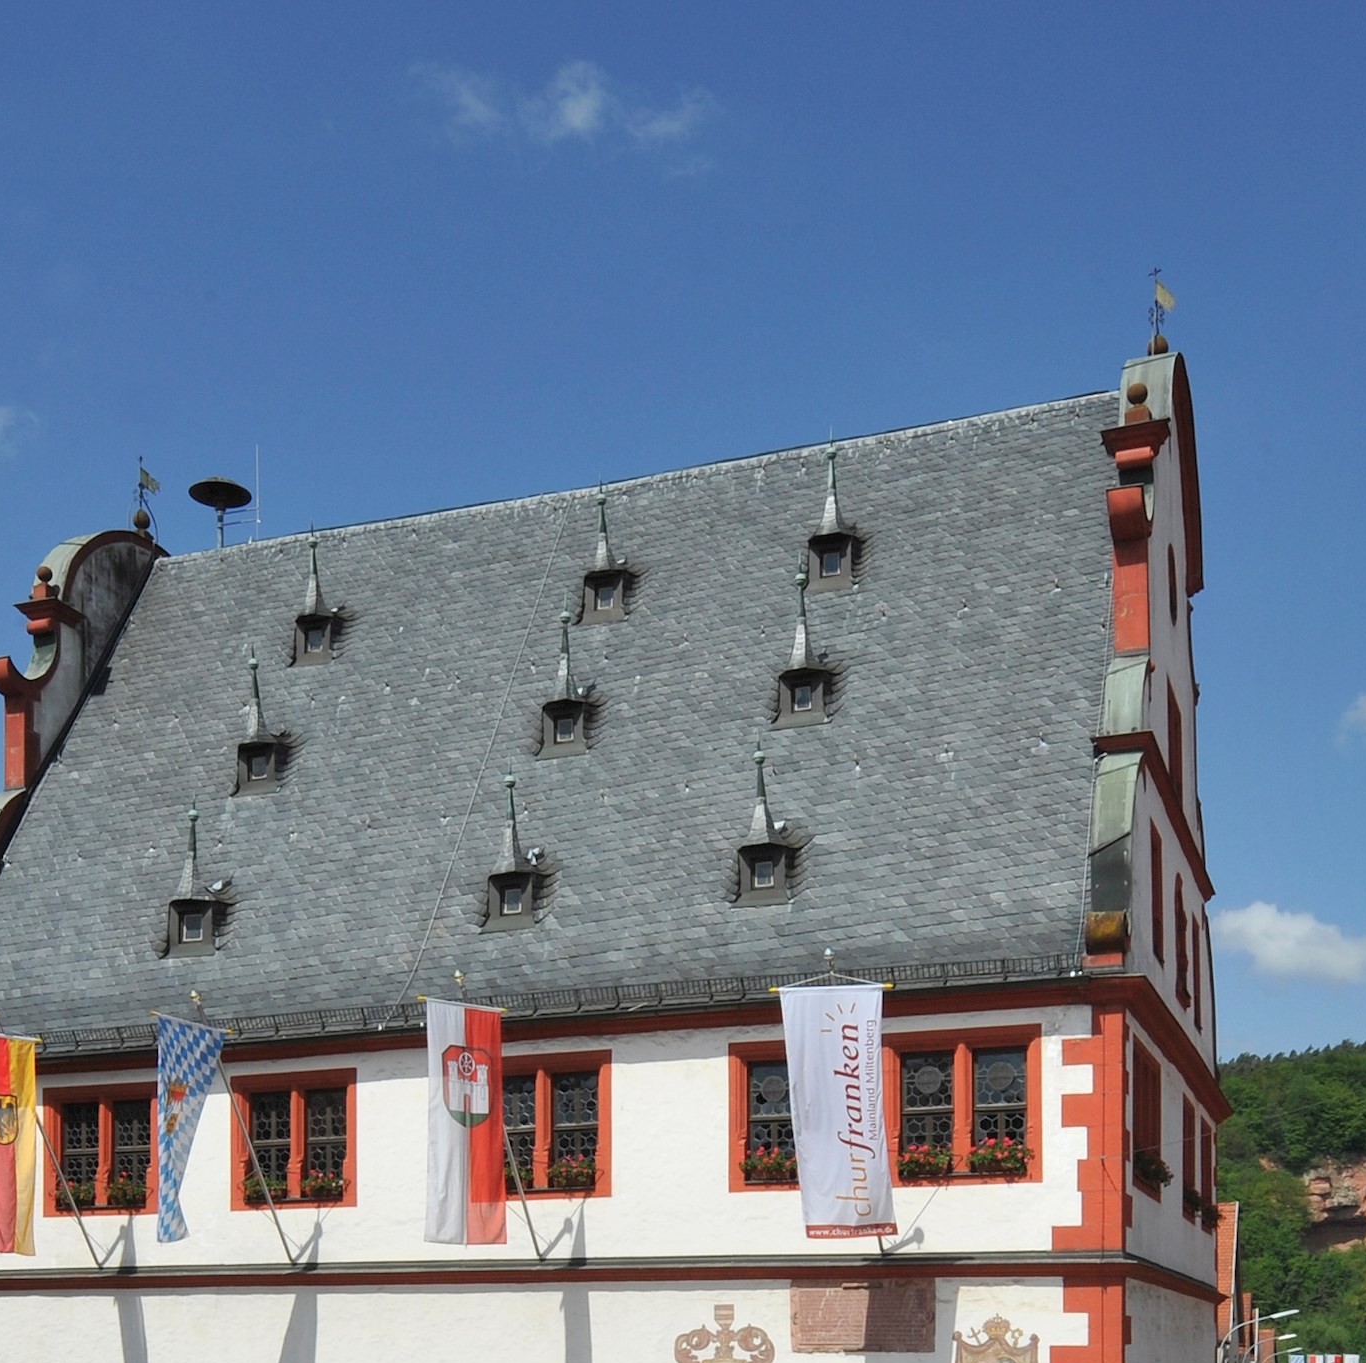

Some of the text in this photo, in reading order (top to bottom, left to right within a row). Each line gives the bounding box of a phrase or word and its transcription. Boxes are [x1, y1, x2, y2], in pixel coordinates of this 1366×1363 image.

[834, 1022, 875, 1217] churfranken
[865, 1019, 878, 1141] Mainland Miltenberg
